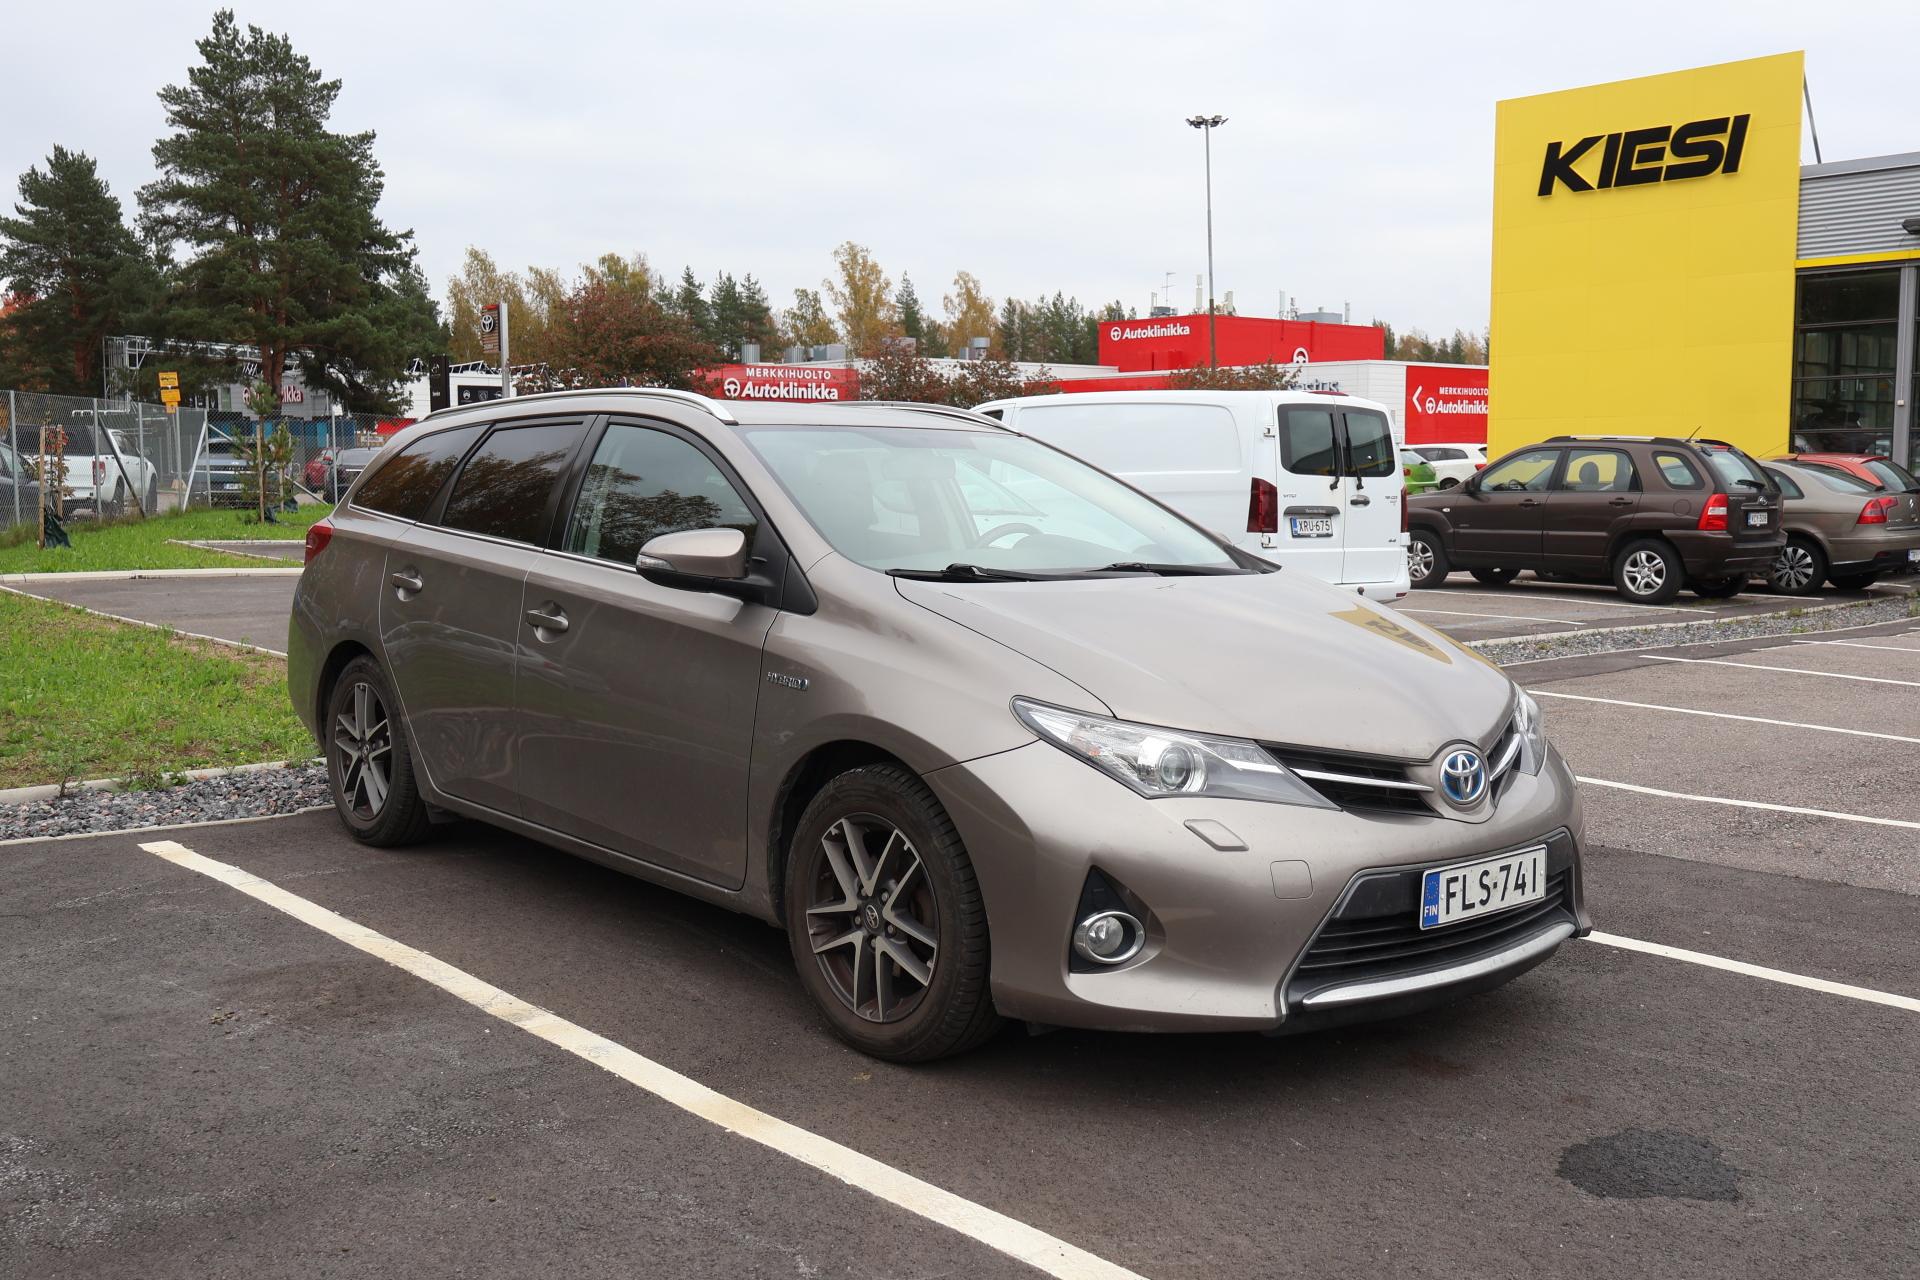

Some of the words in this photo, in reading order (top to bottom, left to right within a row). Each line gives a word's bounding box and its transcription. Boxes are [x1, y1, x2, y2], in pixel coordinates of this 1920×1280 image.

[1537, 113, 1751, 197] KIESI
[1122, 322, 1191, 340] Autoklinikka
[746, 367, 832, 380] MERKKIHUOLTO
[740, 381, 839, 400] Autoklinikka
[1439, 386, 1489, 396] MERKKIHUOLTO
[1299, 520, 1331, 532] XRU-675
[1445, 857, 1538, 915] FLS-741
[1424, 904, 1438, 918] FIN
